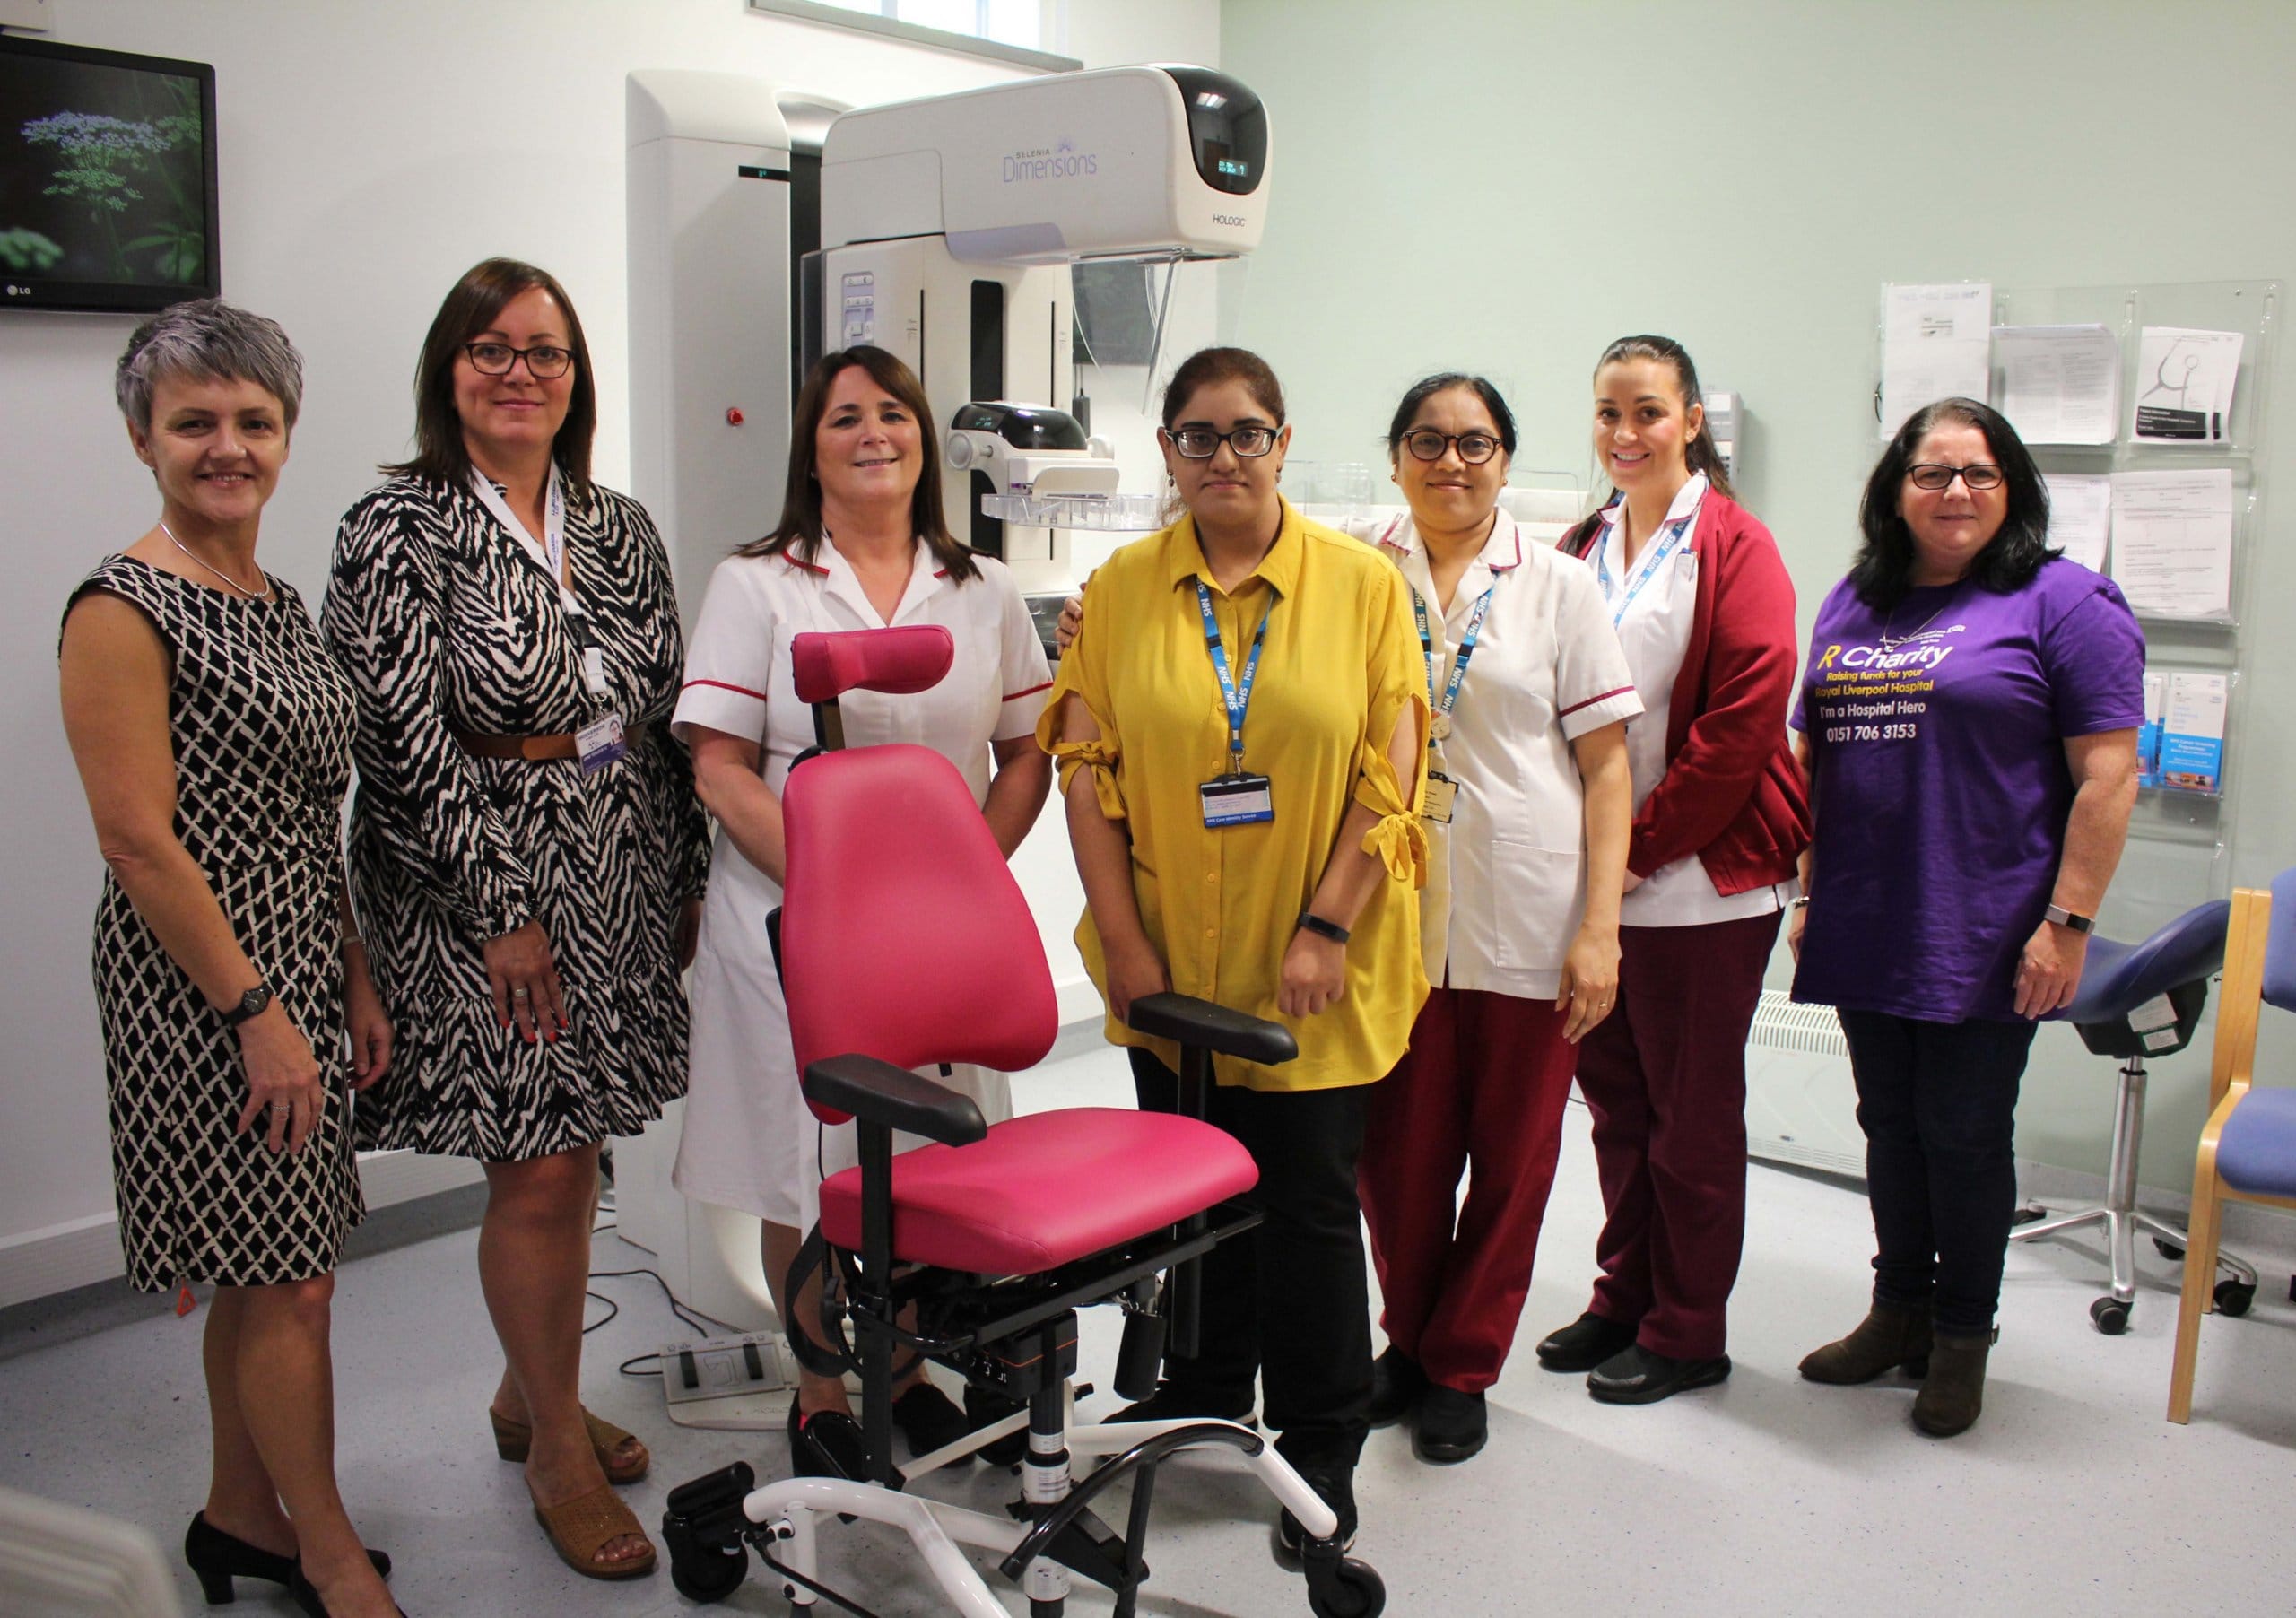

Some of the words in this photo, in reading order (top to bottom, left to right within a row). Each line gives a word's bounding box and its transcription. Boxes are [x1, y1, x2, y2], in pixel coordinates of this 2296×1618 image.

[1016, 148, 1050, 159] SELENIA
[1004, 154, 1097, 183] Dimensions
[1213, 214, 1246, 228] HOLOGIC
[19, 287, 31, 295] LG
[1661, 534, 1676, 552] NHS
[1647, 554, 1662, 572] NHS
[1417, 613, 1427, 631] NHS
[1200, 598, 1213, 617] NHS
[1217, 666, 1231, 684] NHS
[1224, 691, 1238, 710] NHS
[1841, 646, 1953, 669] Charity
[1243, 662, 1255, 681] NHS
[1449, 667, 1463, 689] NHS
[1826, 671, 1858, 682] Raising
[1860, 671, 1885, 681] funds
[1887, 669, 1900, 679] for
[1902, 669, 1923, 680] your
[1238, 687, 1248, 708] NHS
[1815, 684, 1840, 699] Royal
[1843, 683, 1889, 697] Liverpool
[1891, 679, 1934, 694] Hospital
[1820, 706, 1835, 718] I'm
[1838, 707, 1845, 718] a
[1848, 700, 1895, 719] Hospital
[1897, 700, 1926, 715] Hero
[1826, 726, 1851, 743] 0151
[1854, 725, 1880, 741] 706
[1883, 723, 1917, 739] 3153
